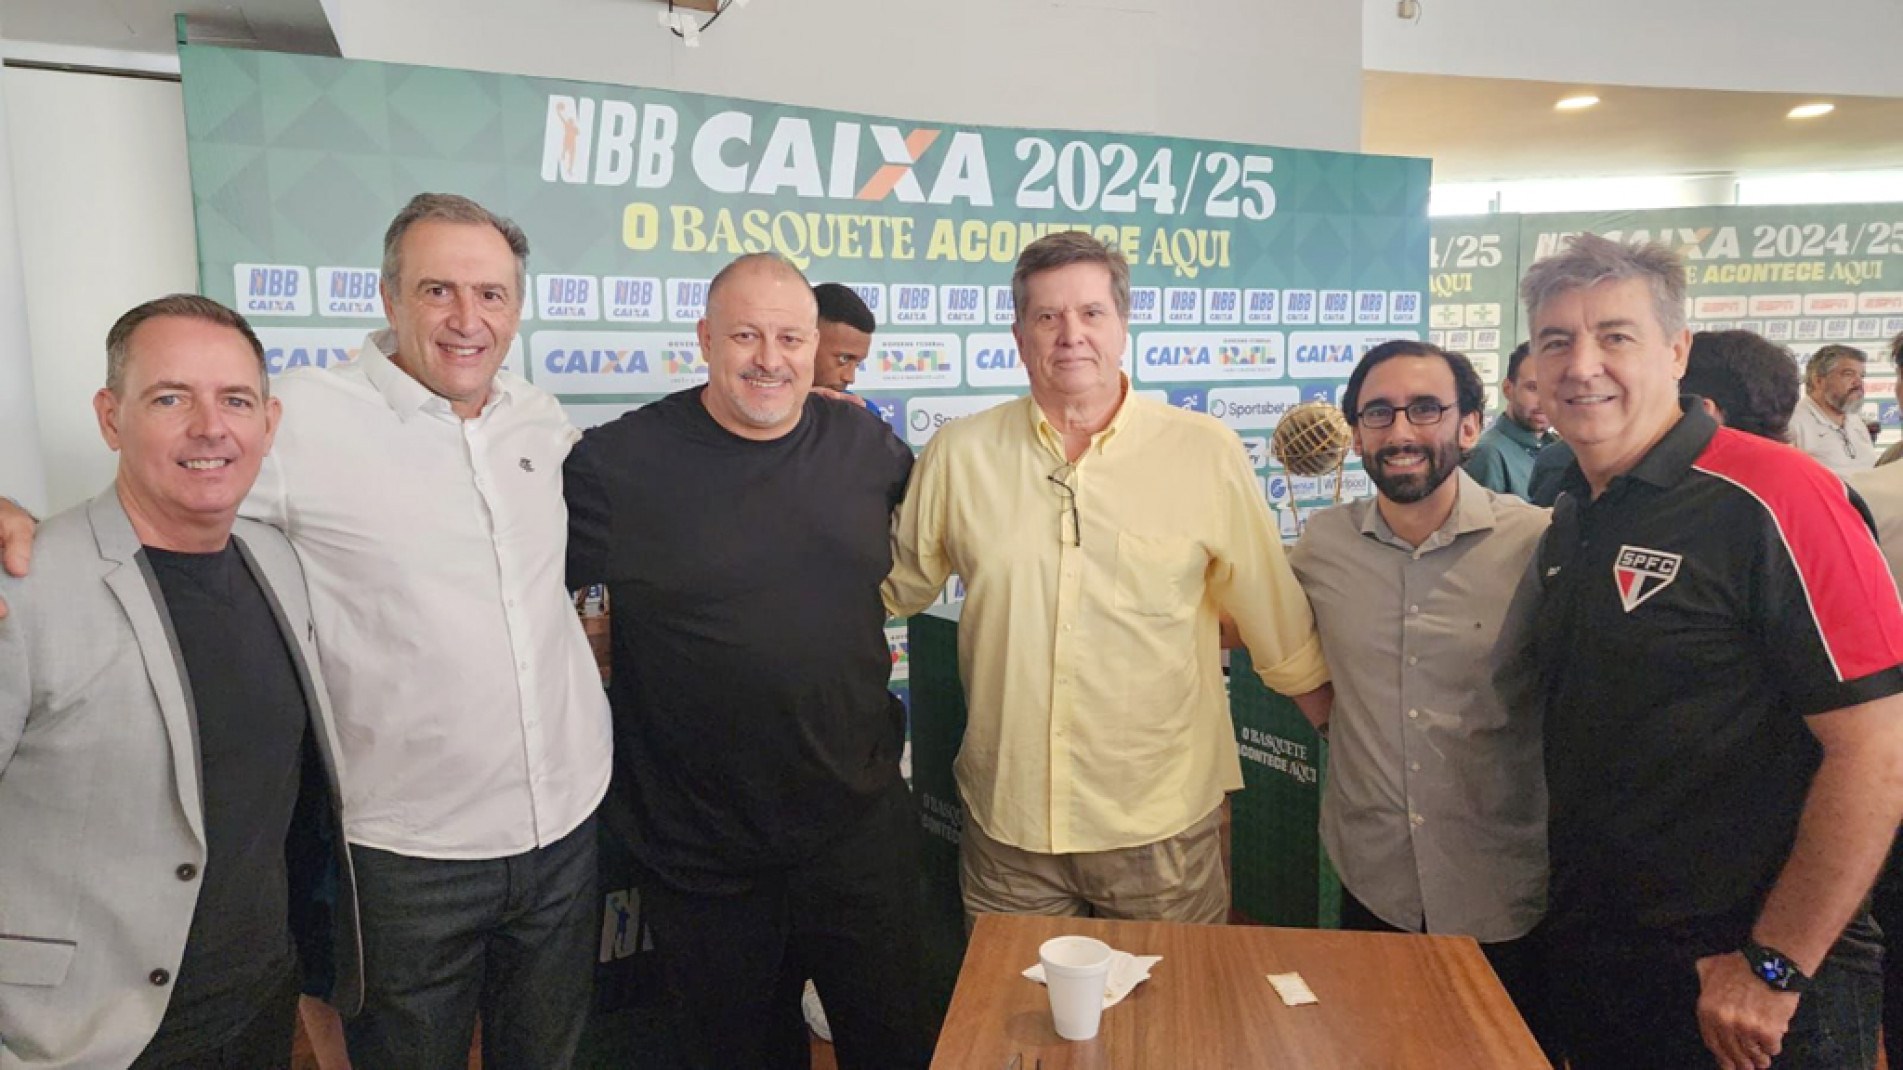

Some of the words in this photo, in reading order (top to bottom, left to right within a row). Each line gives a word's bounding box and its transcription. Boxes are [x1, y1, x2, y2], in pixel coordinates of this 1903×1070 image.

[541, 94, 679, 188] NBB
[690, 110, 993, 206] CAIXA
[1014, 136, 1276, 220] 2024/25
[622, 202, 658, 251] O
[669, 205, 915, 270] BASQUETE
[1147, 226, 1230, 279] AQUI
[249, 268, 299, 297] NBB
[330, 270, 378, 299] NBB
[1702, 262, 1826, 285] ACONTECE
[1828, 259, 1884, 286] AQUI
[549, 278, 590, 304] NBB
[614, 279, 653, 306] NBB
[248, 300, 295, 311] CAIXA
[329, 302, 374, 312] CAIXA
[544, 348, 649, 374] CAIXA
[976, 348, 1018, 370] CAI
[1144, 346, 1211, 366] CAIXA
[1296, 345, 1354, 363] CAIXA
[1621, 551, 1676, 574] SPFC
[1239, 744, 1287, 772] CONTECE
